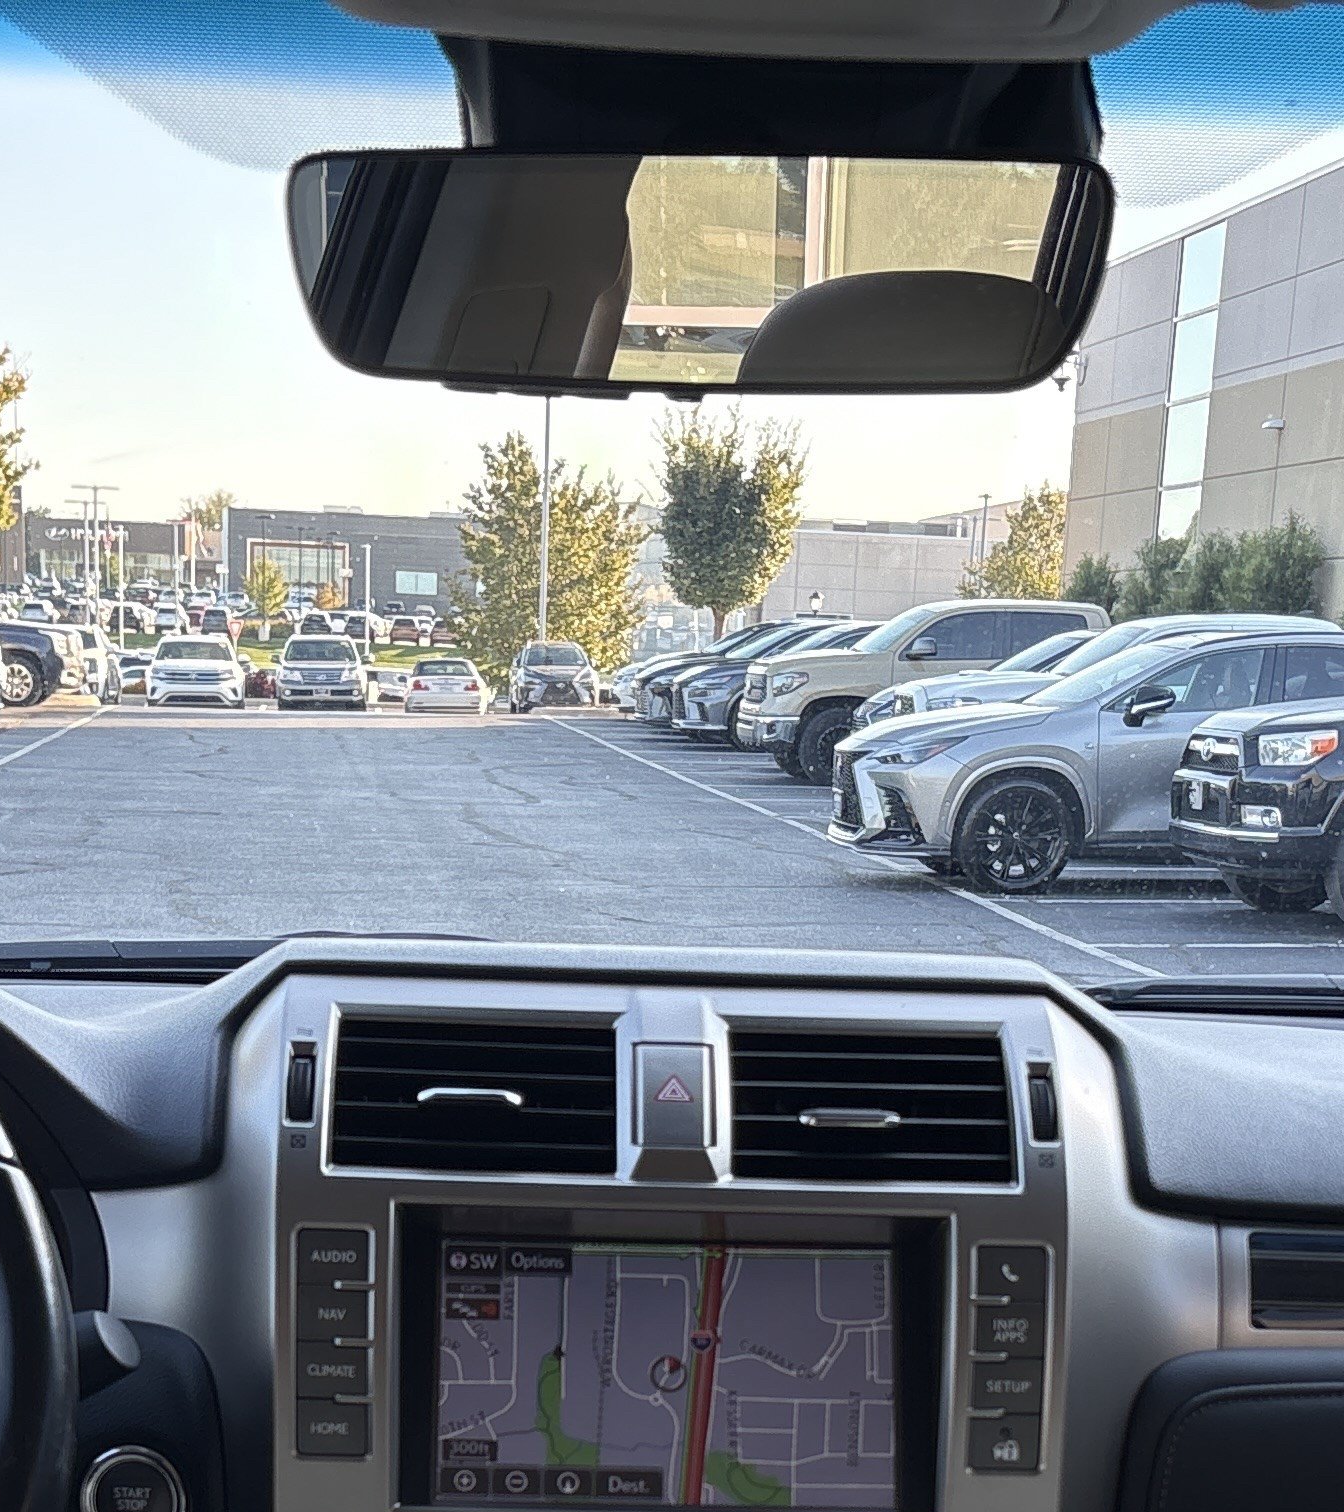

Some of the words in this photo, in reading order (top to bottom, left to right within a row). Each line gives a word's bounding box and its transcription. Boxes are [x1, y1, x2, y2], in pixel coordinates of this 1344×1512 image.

[310, 1251, 357, 1263] AUDIO
[470, 1252, 498, 1269] SW
[511, 1251, 565, 1271] Options
[318, 1307, 346, 1320] NAV
[992, 1318, 1029, 1332] INFO
[994, 1331, 1028, 1345] APPS
[307, 1364, 356, 1378] CLIMATE
[986, 1380, 1032, 1393] SETUP
[310, 1421, 349, 1435] HOME
[608, 1475, 650, 1494] Dest.
[113, 1487, 152, 1498] START
[117, 1499, 147, 1510] STOP
